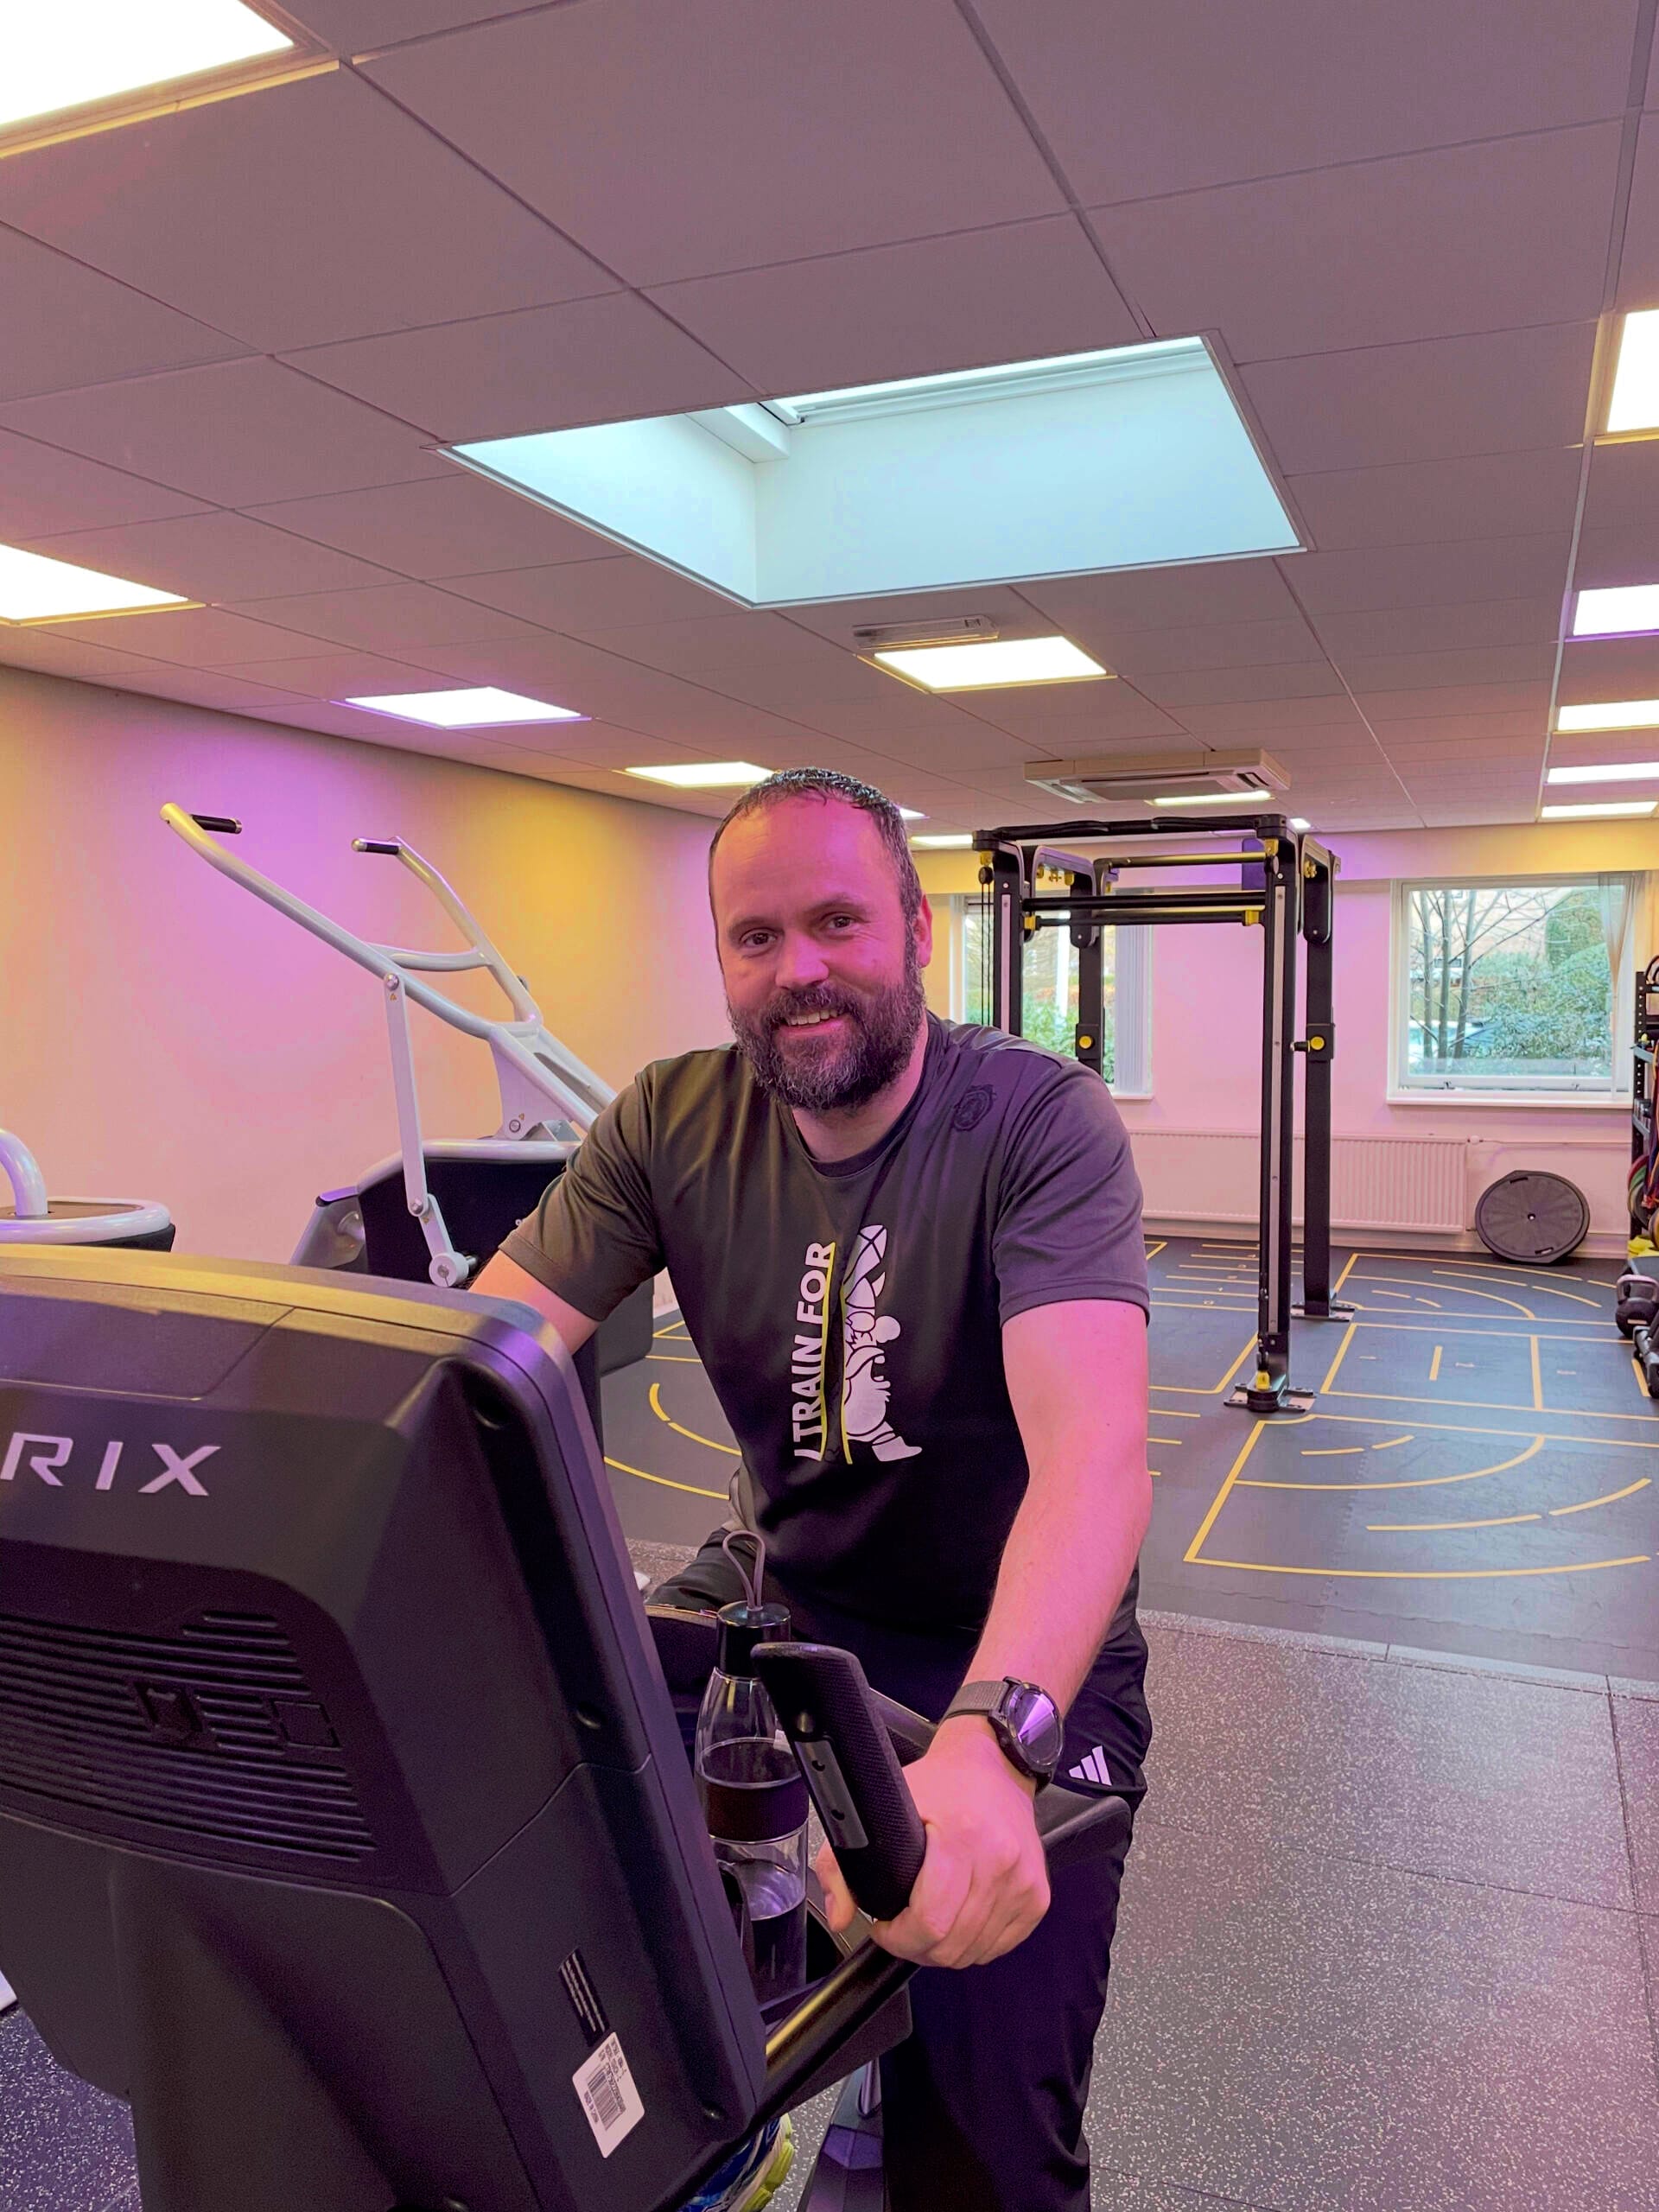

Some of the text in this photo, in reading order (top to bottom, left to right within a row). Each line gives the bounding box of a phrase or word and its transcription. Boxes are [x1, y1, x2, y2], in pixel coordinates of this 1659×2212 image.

[791, 1242, 835, 1462] I TRAIN FOR
